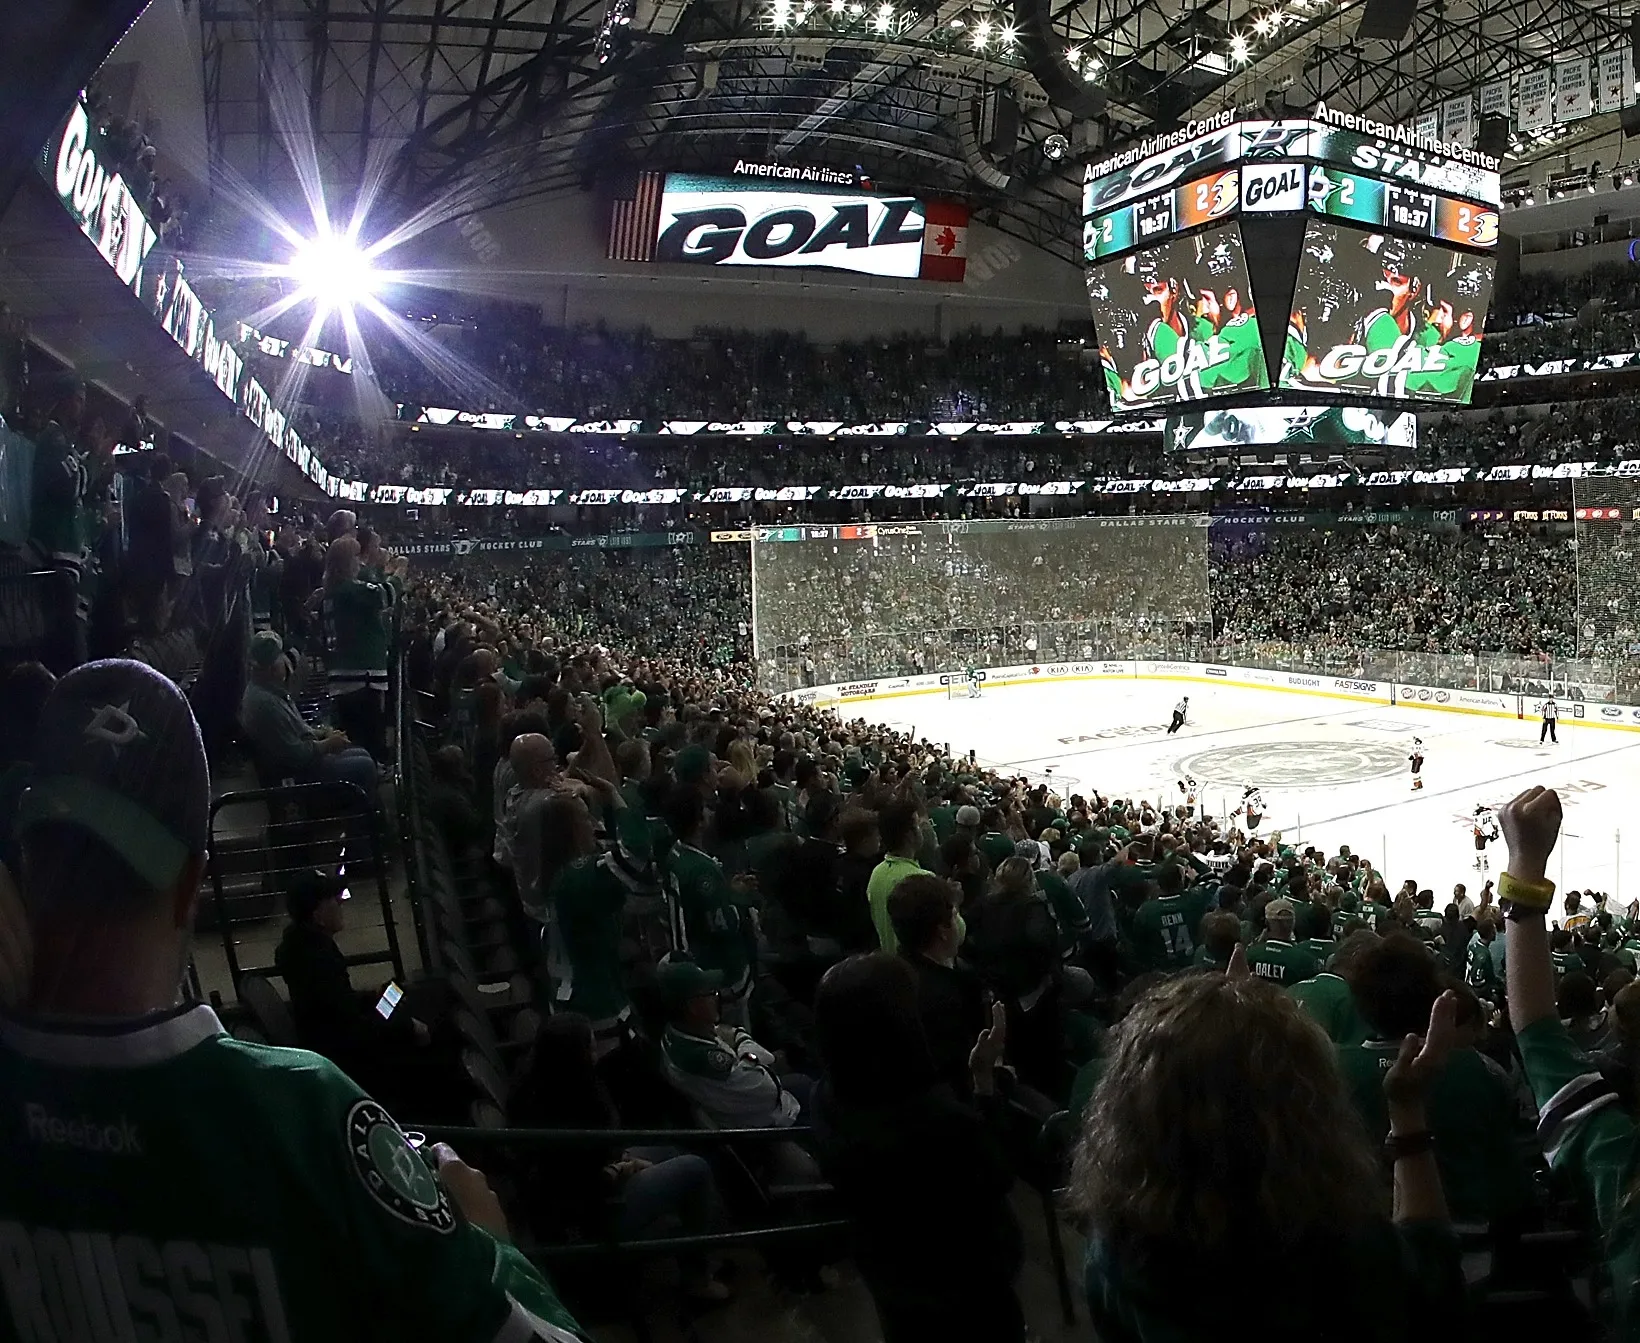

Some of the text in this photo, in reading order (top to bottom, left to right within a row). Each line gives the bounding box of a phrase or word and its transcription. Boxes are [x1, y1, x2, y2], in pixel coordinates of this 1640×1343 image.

[734, 160, 853, 185] American Airlines
[1196, 183, 1209, 211] 2
[1246, 168, 1300, 206] GOAL
[1340, 177, 1355, 206] 2
[656, 196, 926, 264] GOAL
[1103, 218, 1113, 243] 2
[1458, 207, 1471, 234] 2
[1131, 335, 1231, 398] GOAL
[1319, 340, 1450, 382] GOAL
[877, 526, 907, 536] CyrusOne
[1149, 518, 1186, 526] STARS
[1275, 515, 1306, 523] CLUB
[388, 540, 544, 555] DALLAS STARS HOCKEY CLUB
[571, 539, 597, 547] STARS
[940, 671, 986, 685] GEIO
[1050, 666, 1065, 674] KIA
[1288, 677, 1320, 687] BUD LIGHT
[1334, 680, 1377, 692] FASTSIGNS
[841, 688, 876, 698] MOTORCARS
[1255, 962, 1285, 979] DALEY
[25, 1101, 144, 1156] Reebok
